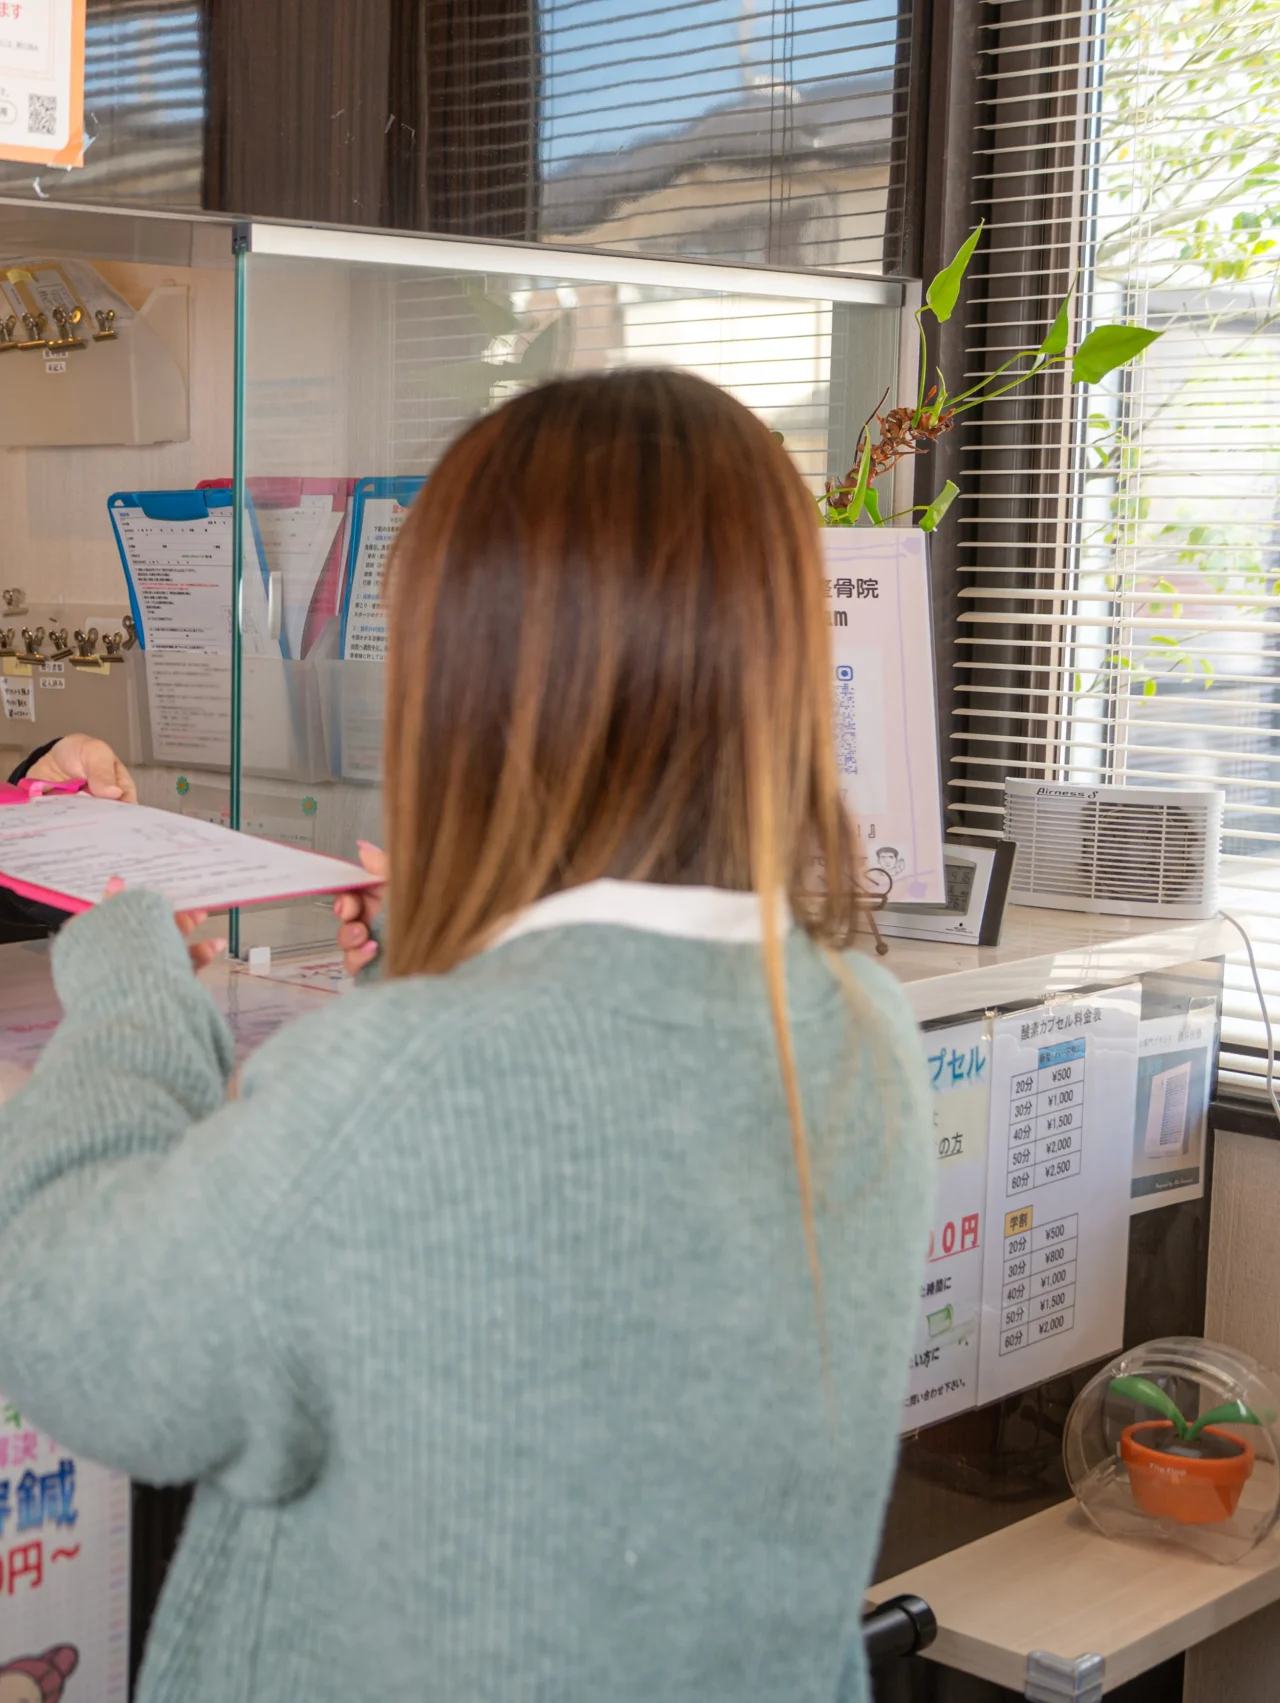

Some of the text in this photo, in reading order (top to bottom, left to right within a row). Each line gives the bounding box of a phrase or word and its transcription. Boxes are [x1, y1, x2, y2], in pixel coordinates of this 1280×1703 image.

[1036, 787, 1085, 798] Airness
[1021, 1007, 1102, 1040] 酸素カプセル料金表
[927, 1046, 987, 1081] プセル
[1015, 1066, 1072, 1093] 20分 ¥500
[1014, 1088, 1074, 1117] 30分 ¥1,000
[1013, 1112, 1073, 1140] 40分 ¥1,500
[938, 1132, 964, 1155] の方
[1012, 1136, 1072, 1165] 50分 ¥2,000
[1011, 1159, 1071, 1189] 60分 ¥2,500
[1009, 1212, 1028, 1230] 学割
[1008, 1224, 1065, 1254] 20分 ¥500
[1007, 1248, 1065, 1278] 30分 ¥800
[1006, 1269, 1067, 1301] 40分 ¥1,000
[1005, 1292, 1065, 1325] 50分 ¥1,500
[1004, 1315, 1064, 1349] 60分 ¥2,000
[910, 1347, 940, 1369] い方に
